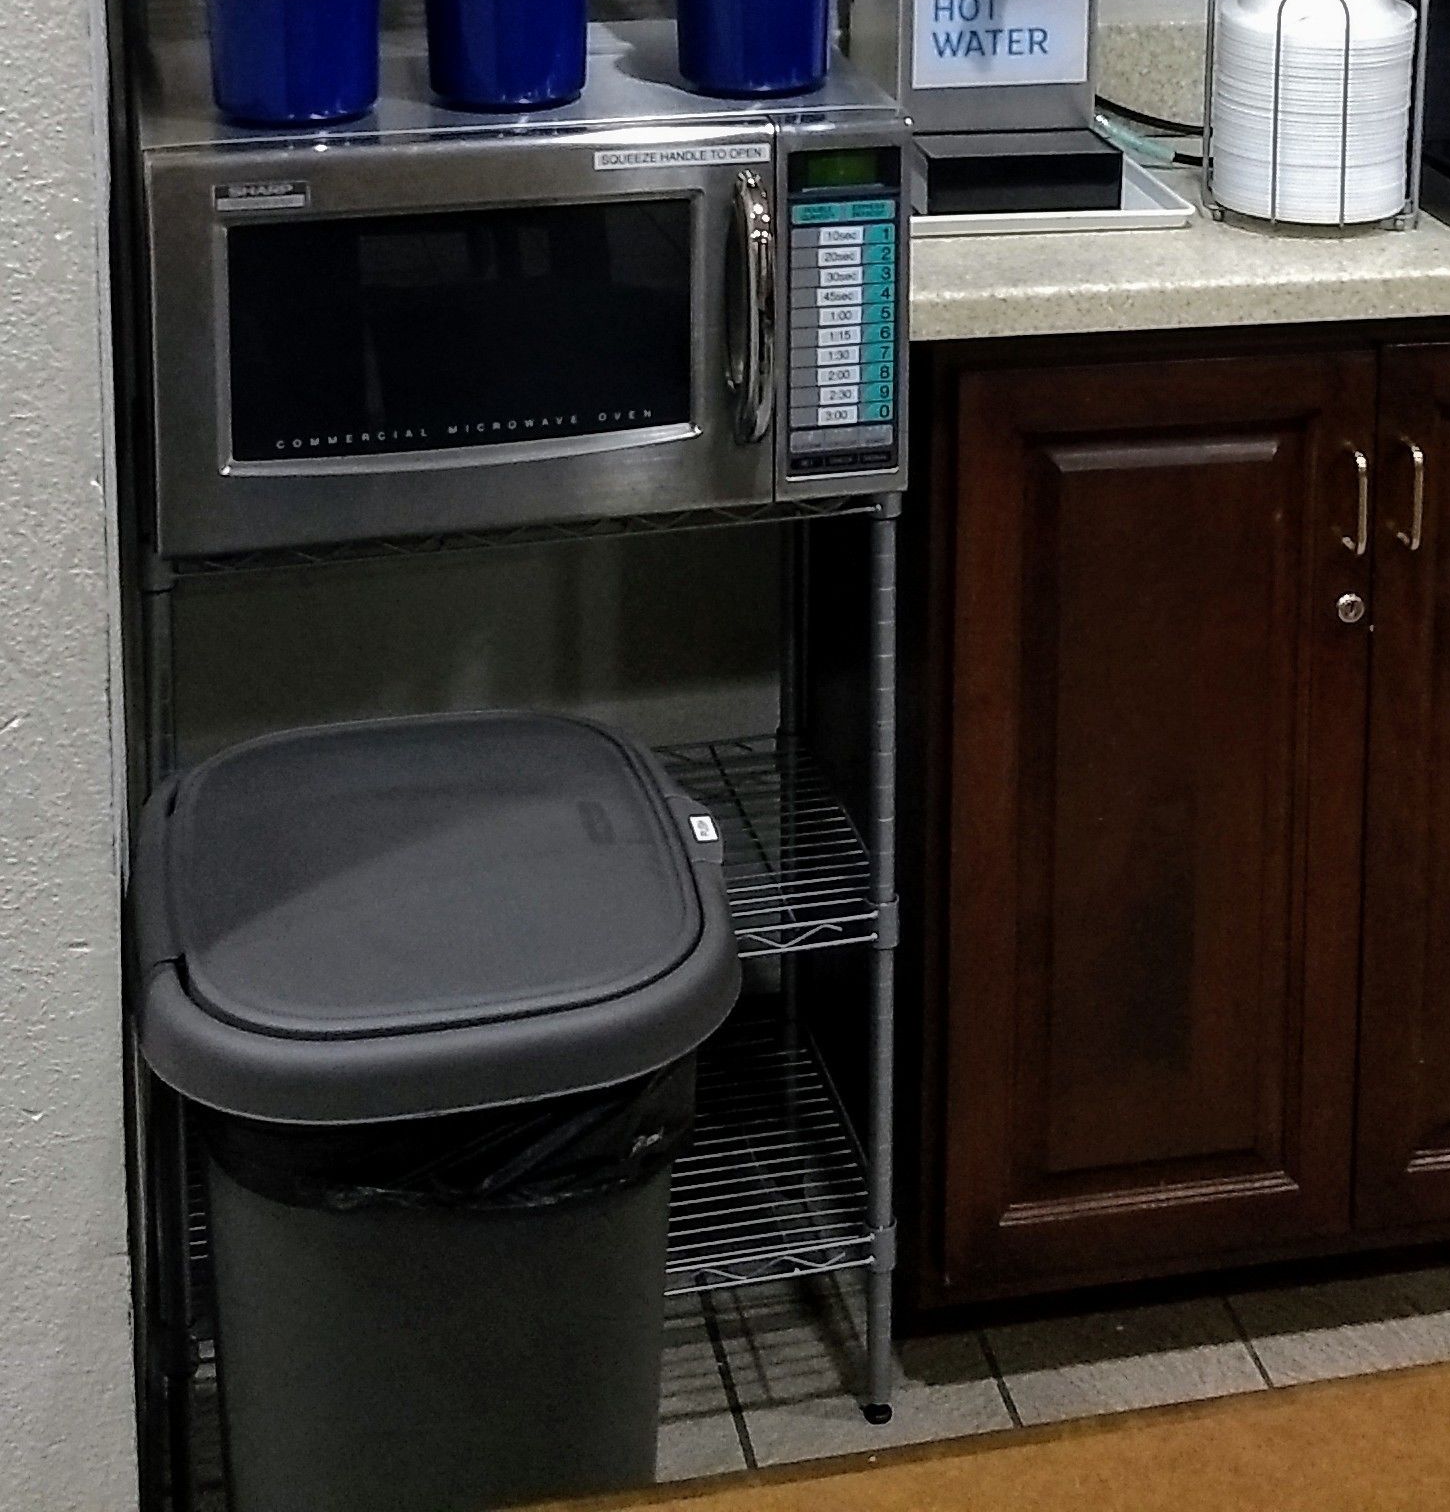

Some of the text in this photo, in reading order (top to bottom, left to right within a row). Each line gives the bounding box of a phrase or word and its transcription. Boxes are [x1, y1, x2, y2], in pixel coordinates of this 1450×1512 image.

[932, 28, 1049, 58] WATER
[601, 147, 762, 166] SQUEEZE HANDLE TO OPEN
[883, 228, 889, 240] 1
[881, 248, 891, 261] 2
[881, 268, 891, 281] 3
[880, 287, 891, 300] 4
[880, 306, 891, 320] 5
[880, 326, 891, 339] 6
[880, 346, 890, 359] 7
[880, 365, 890, 379] 8
[880, 385, 890, 398] 9
[879, 404, 890, 418] 0
[275, 428, 428, 450] COMMERCIAL
[448, 413, 578, 434] MICROWAVE
